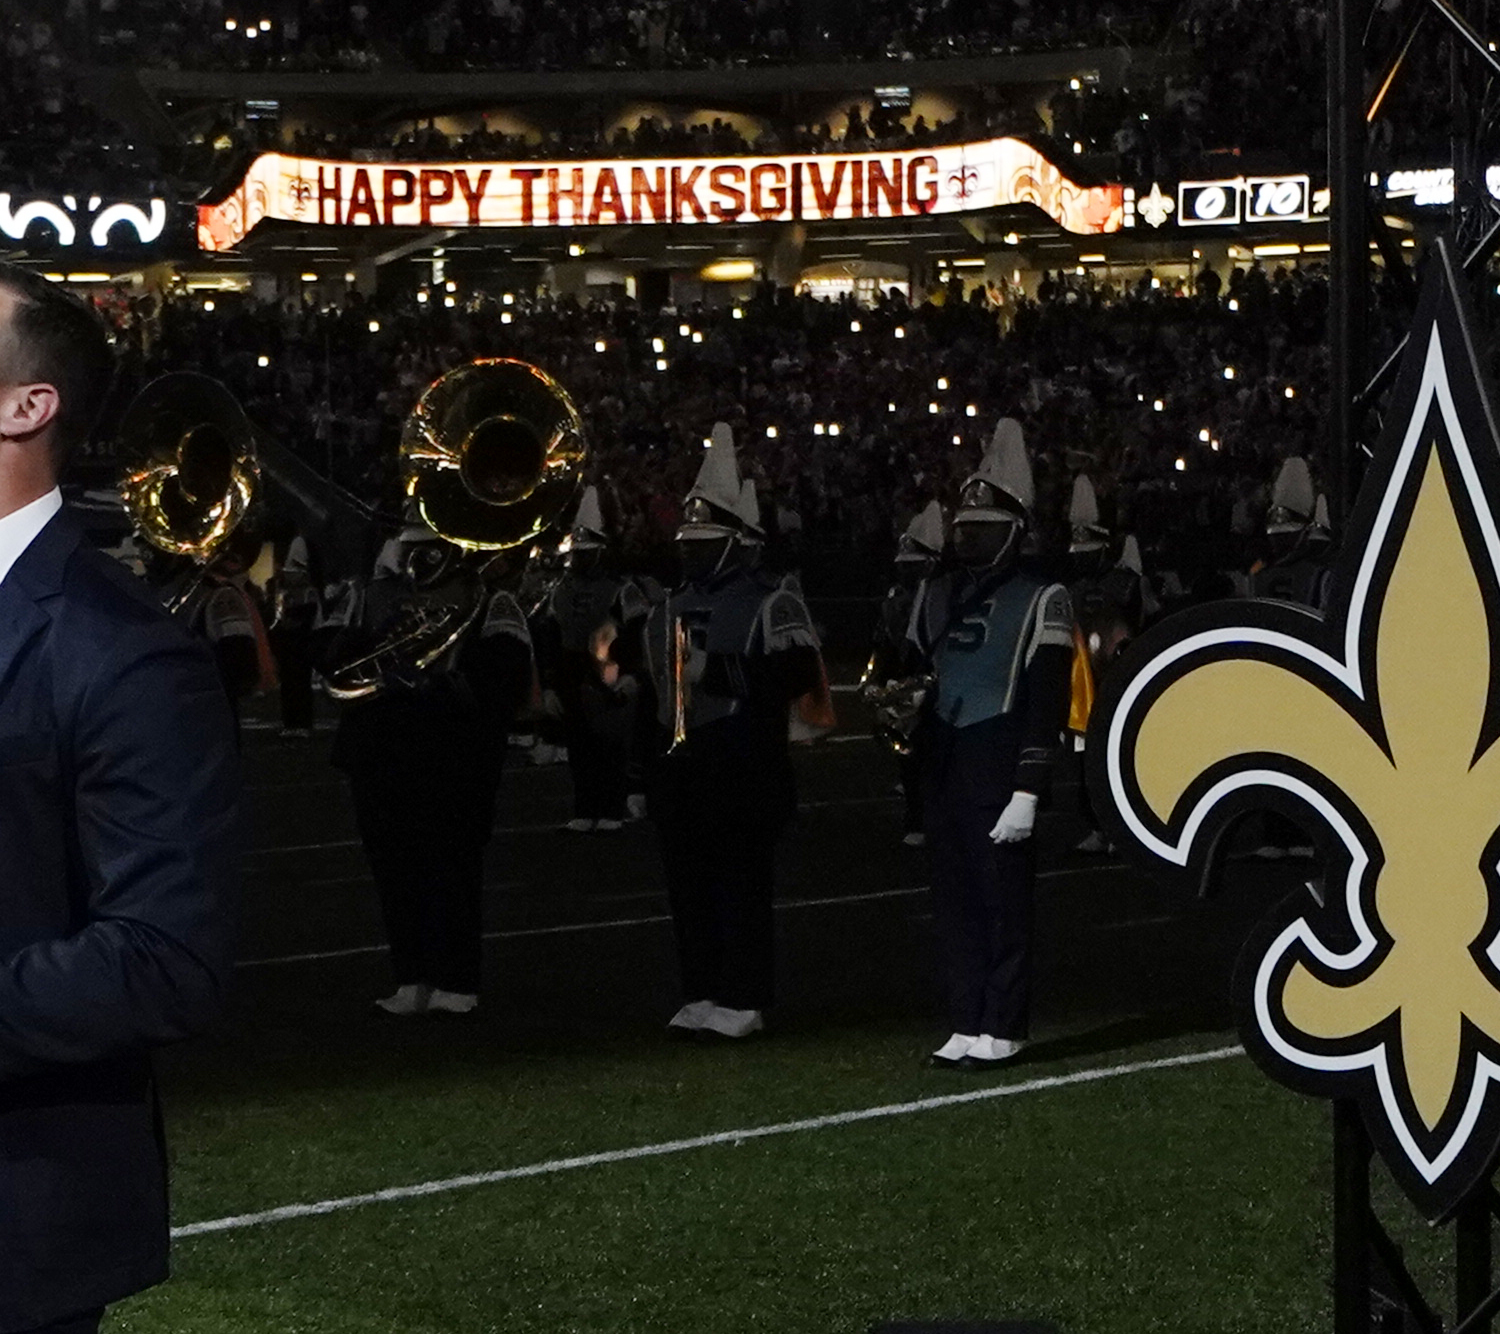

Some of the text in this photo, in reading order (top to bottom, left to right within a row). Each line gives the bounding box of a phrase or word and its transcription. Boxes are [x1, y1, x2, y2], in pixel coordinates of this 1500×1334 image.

[318, 155, 940, 225] HAPPY THANKSGIVING
[1255, 181, 1301, 216] 10
